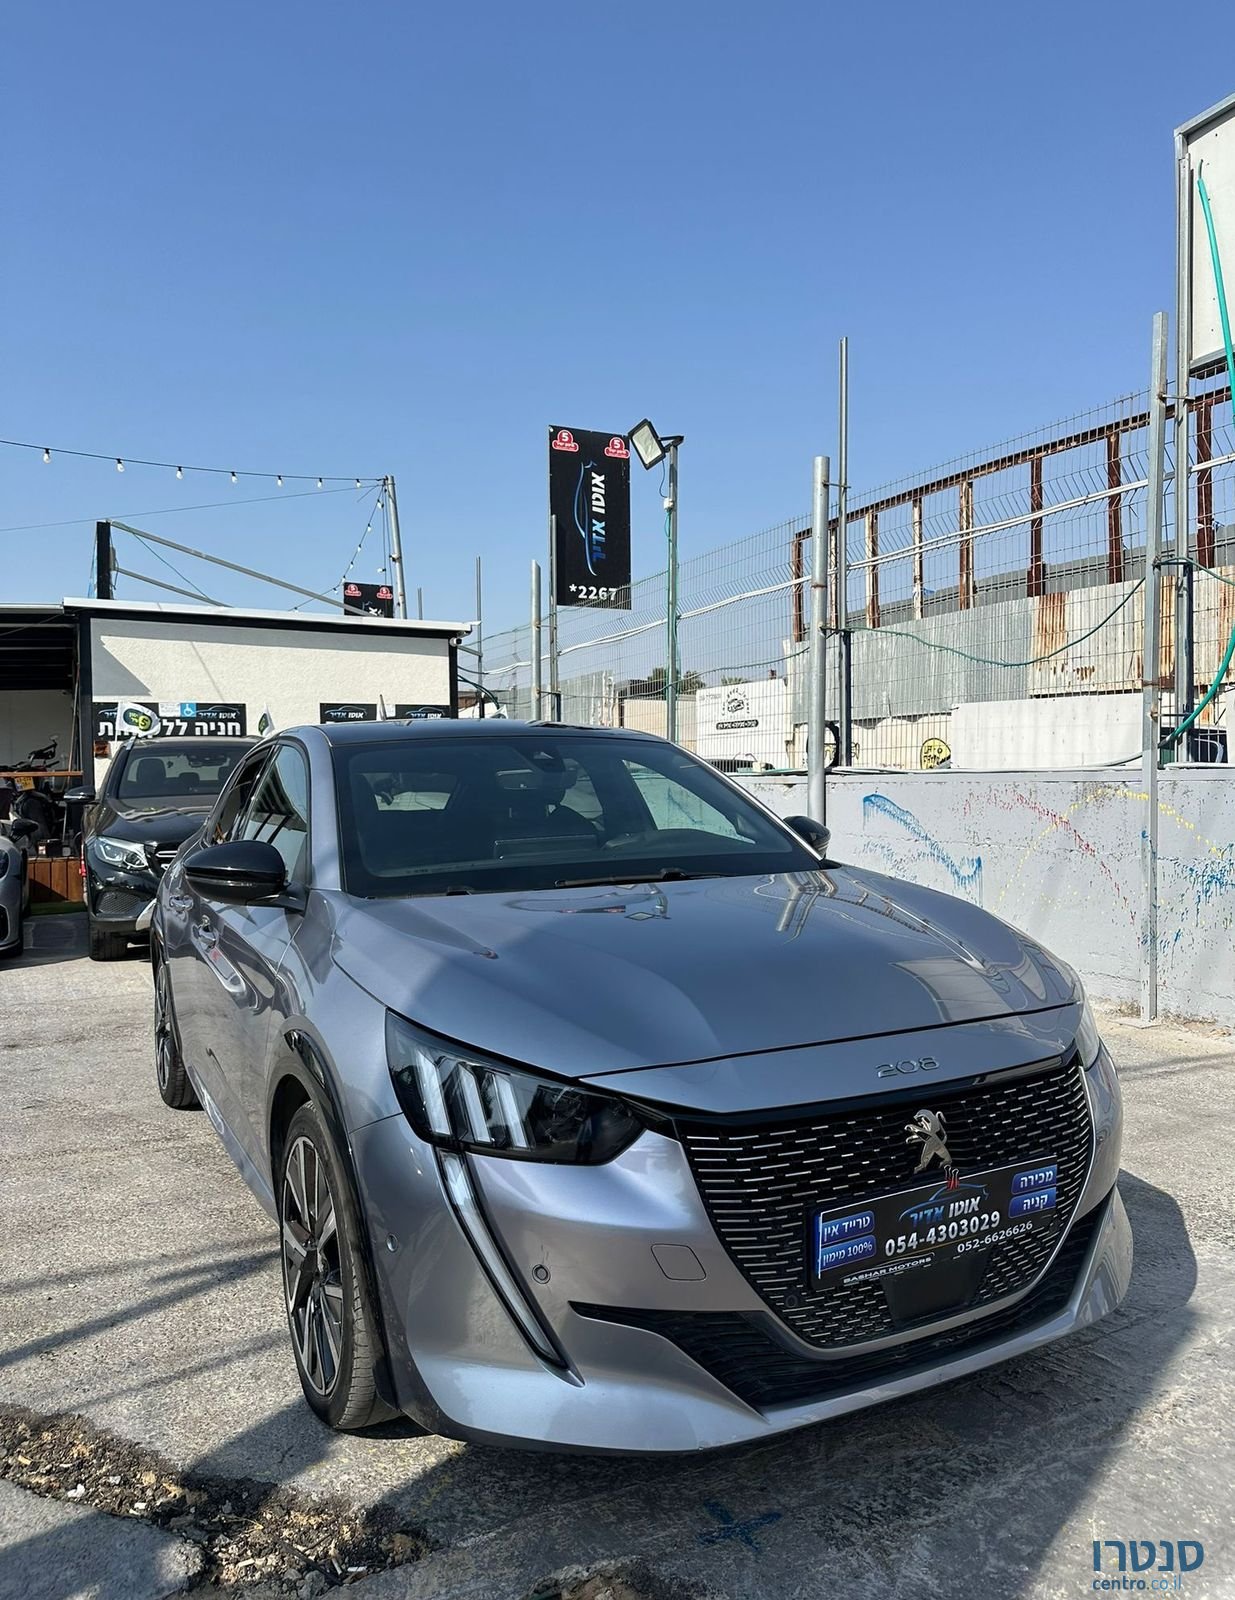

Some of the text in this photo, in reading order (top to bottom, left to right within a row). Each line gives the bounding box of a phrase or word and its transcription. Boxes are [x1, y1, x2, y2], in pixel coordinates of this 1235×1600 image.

[562, 432, 569, 441] 5
[613, 439, 620, 448] 5
[591, 471, 606, 514] אוטו
[195, 721, 241, 736] חניה
[876, 1057, 939, 1078] 208
[1020, 1170, 1054, 1188] מכירה
[910, 1196, 981, 1228] אוטו אדיר
[1023, 1194, 1048, 1210] קניה
[823, 1216, 871, 1242] טרייד אין
[885, 1210, 1001, 1257] 054-4303029
[957, 1220, 1033, 1253] 052-6626626
[823, 1240, 873, 1267] 100% מימון
[843, 1257, 932, 1284] BASHAR MOTORS
